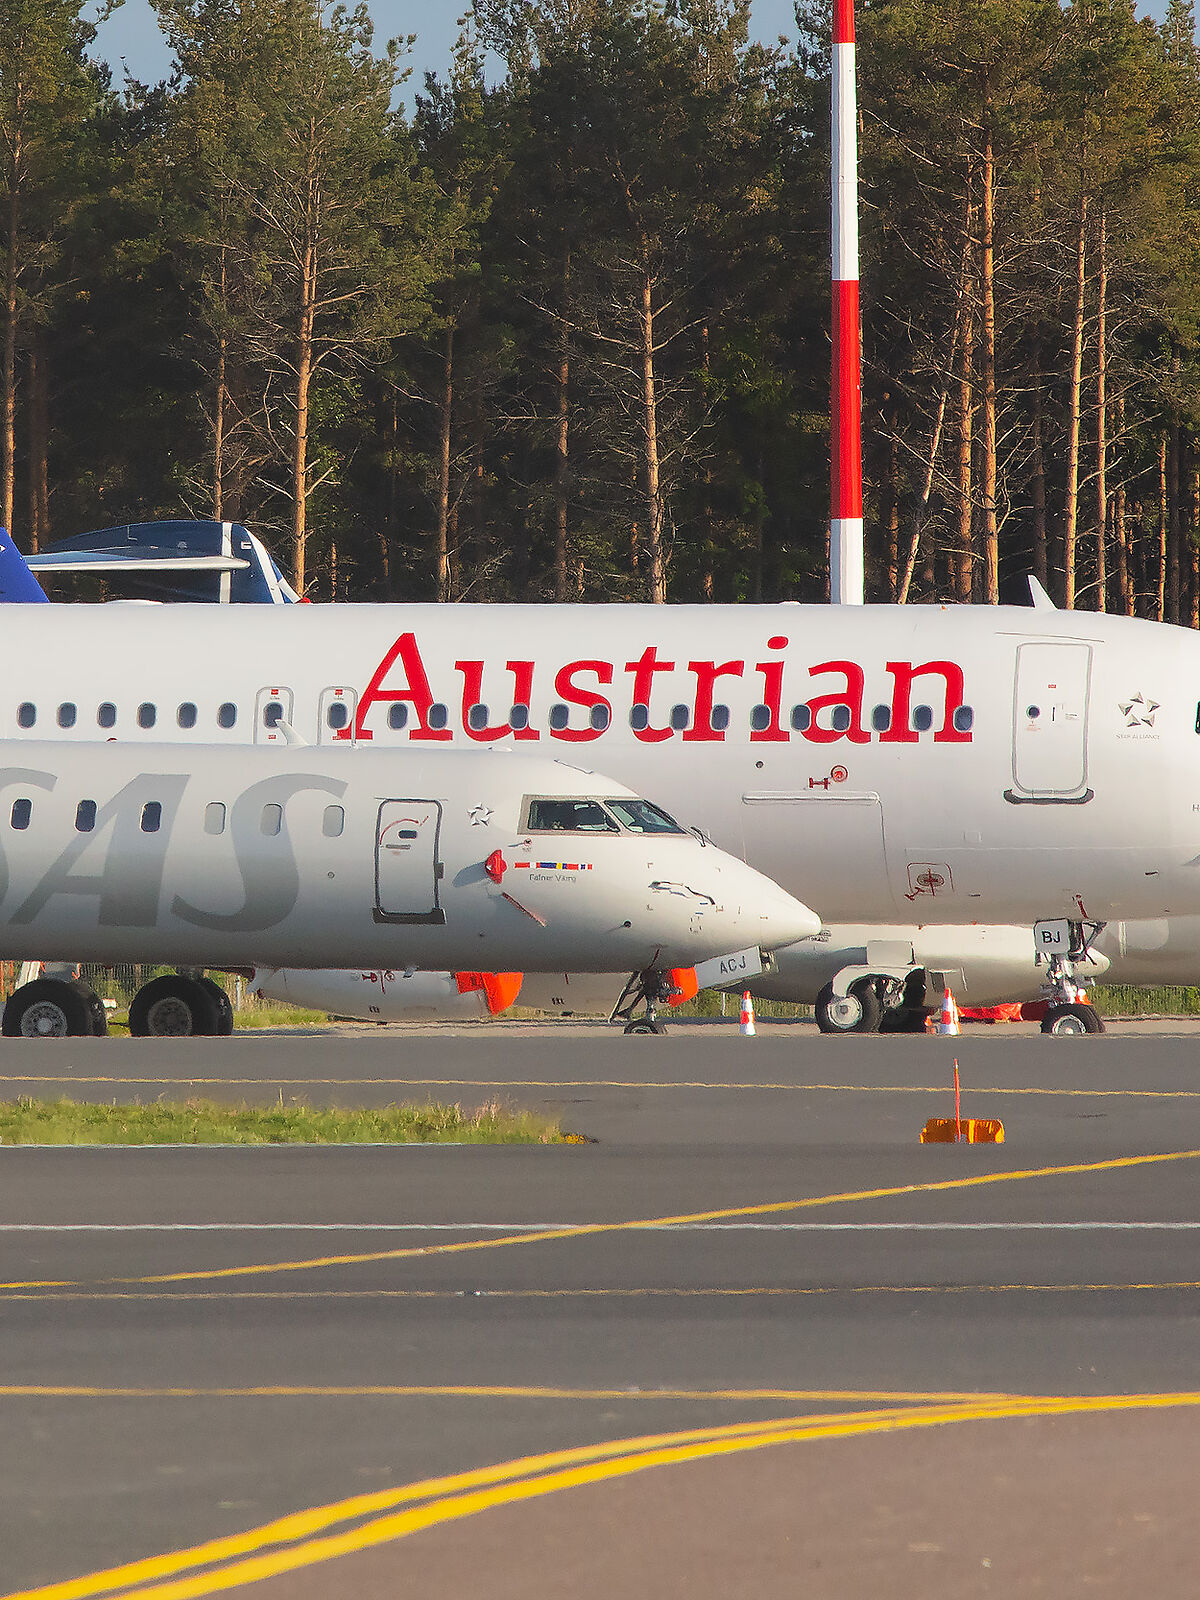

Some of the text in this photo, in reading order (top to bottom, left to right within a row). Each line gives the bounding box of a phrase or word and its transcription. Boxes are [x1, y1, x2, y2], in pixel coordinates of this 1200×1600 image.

[336, 632, 973, 743] Austrian
[1042, 930, 1060, 943] BJ
[720, 955, 746, 974] ACJ
